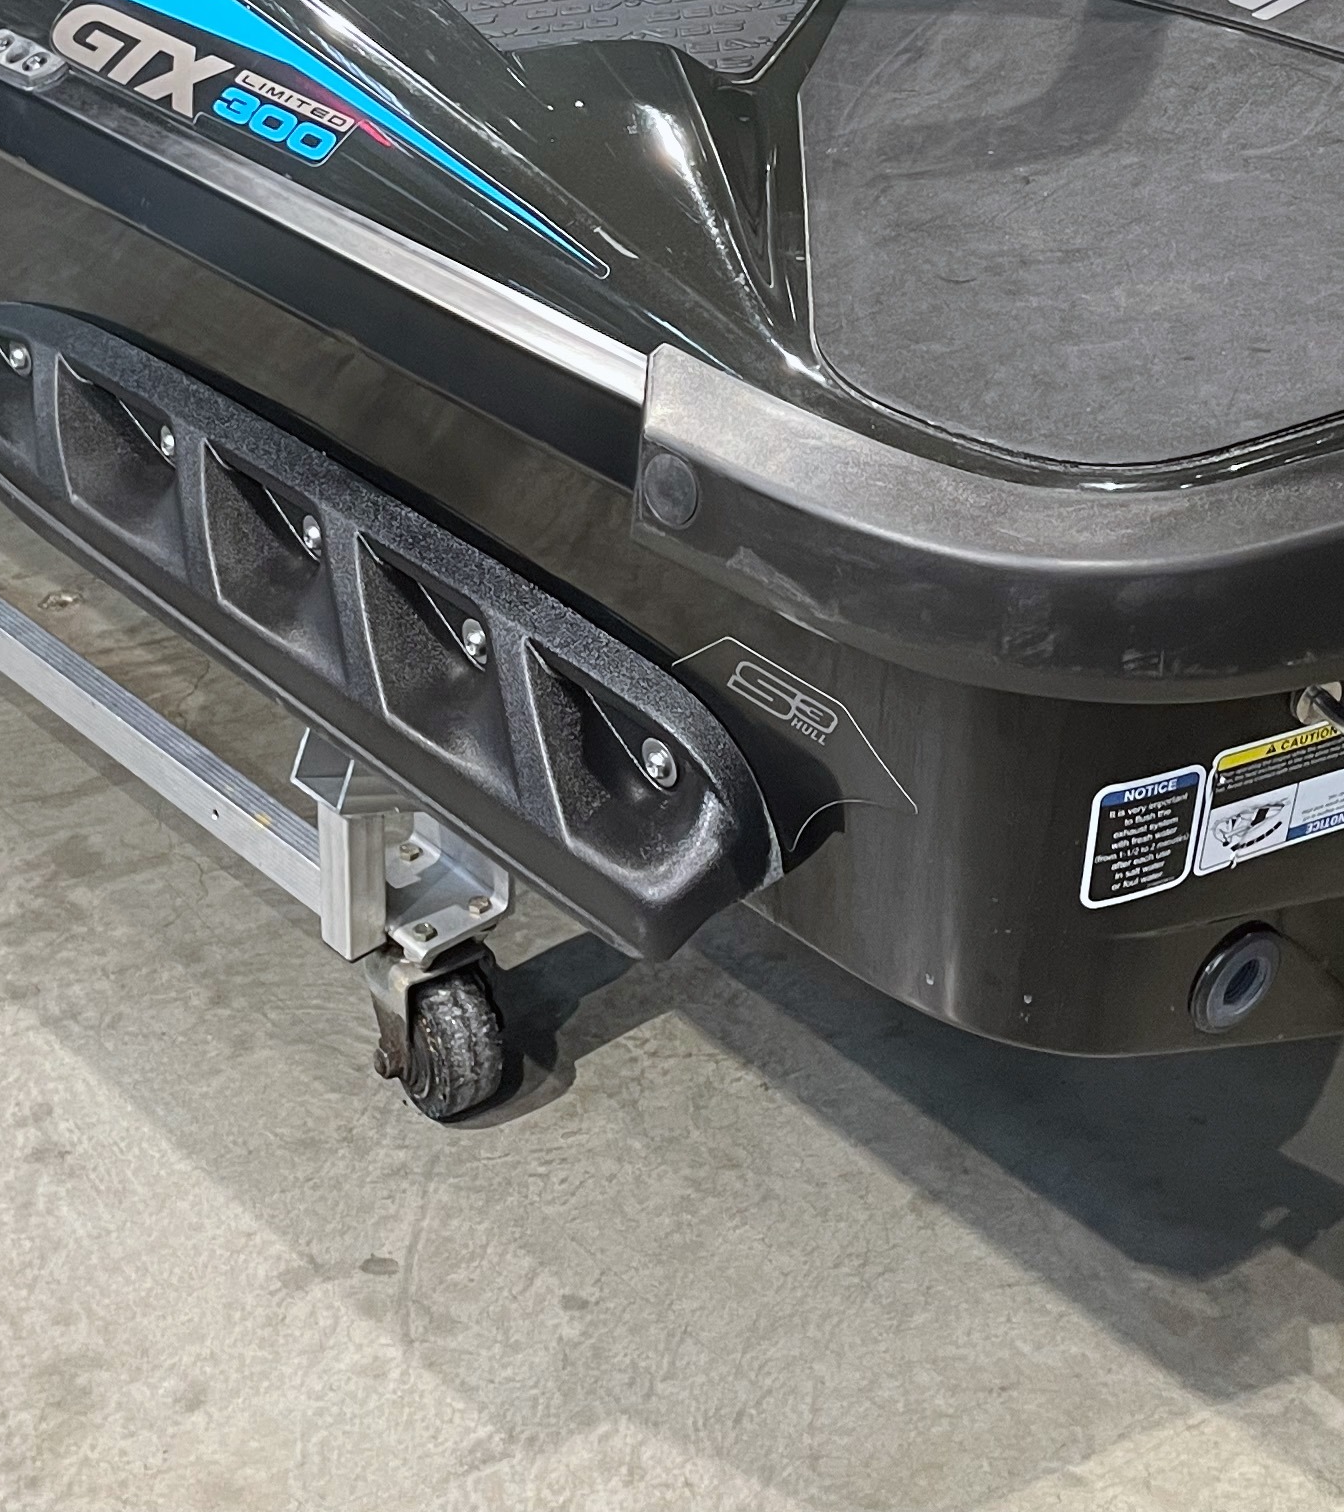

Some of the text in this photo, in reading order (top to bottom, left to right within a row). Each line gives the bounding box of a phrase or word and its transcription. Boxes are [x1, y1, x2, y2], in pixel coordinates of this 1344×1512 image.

[52, 3, 234, 118] GTX
[241, 73, 355, 130] LIMITED
[212, 86, 338, 161] 300
[791, 718, 826, 746] HULL
[1280, 725, 1338, 751] CAUTION
[1124, 778, 1178, 802] NOTICE
